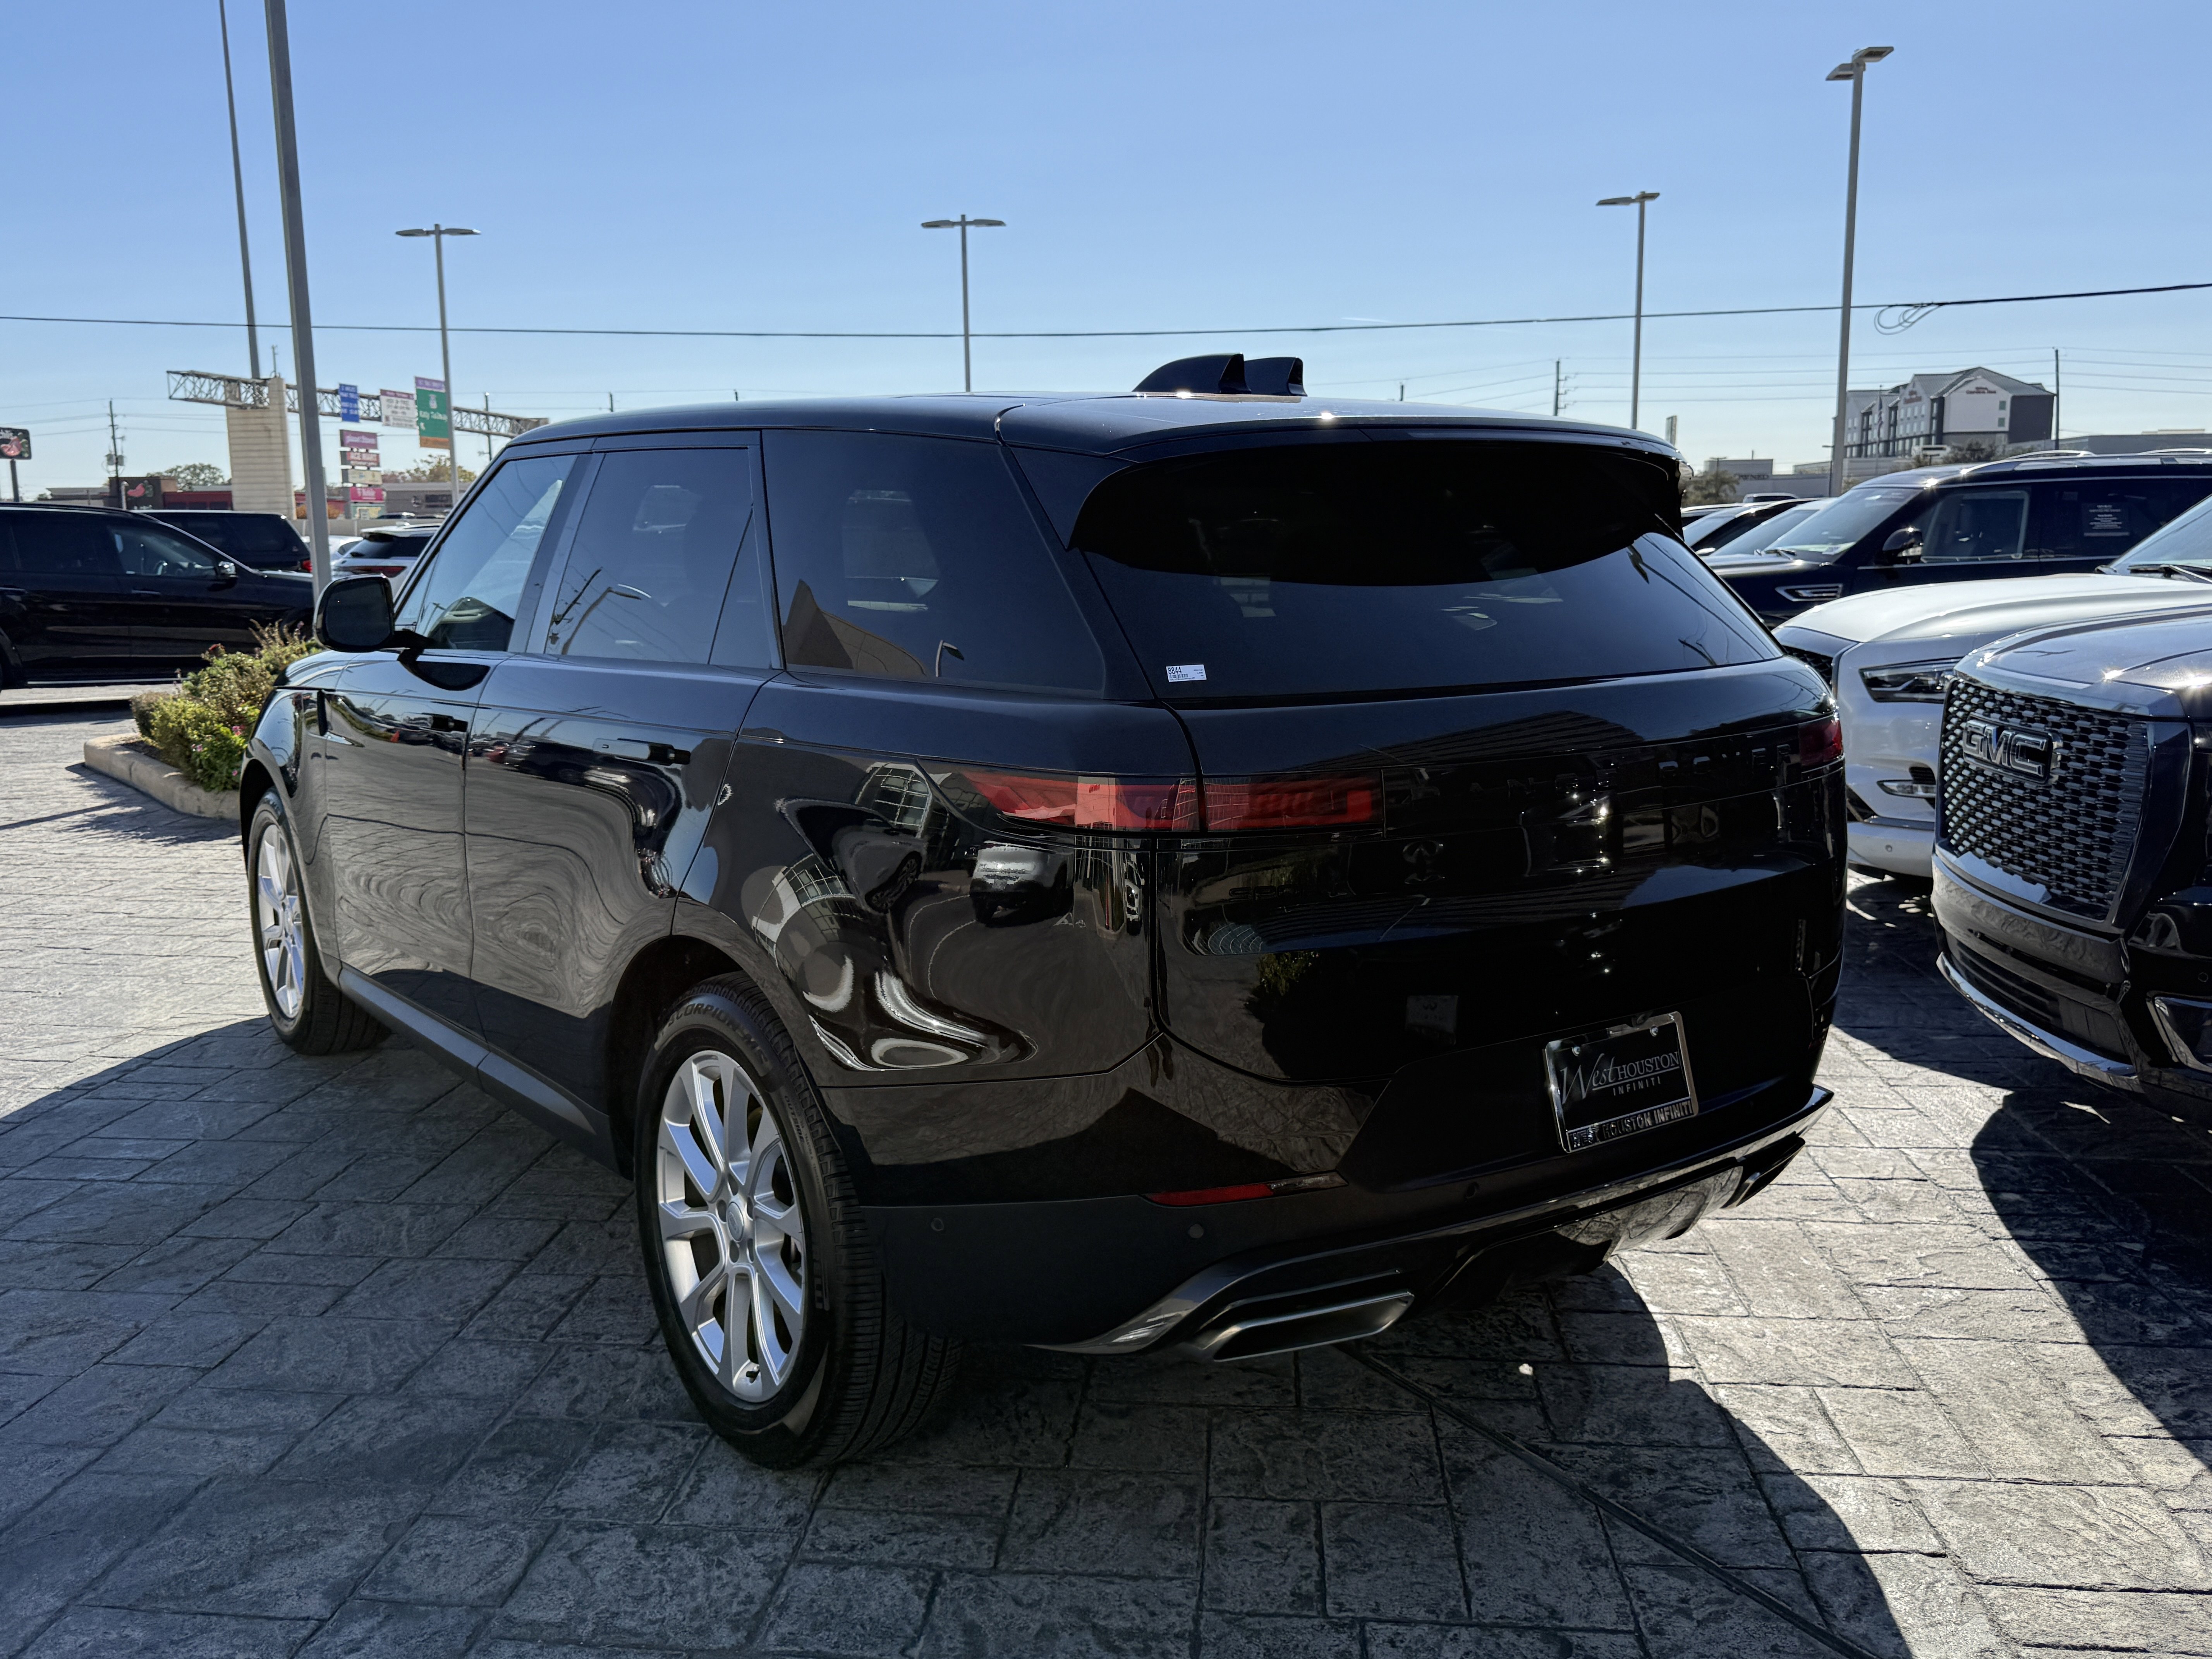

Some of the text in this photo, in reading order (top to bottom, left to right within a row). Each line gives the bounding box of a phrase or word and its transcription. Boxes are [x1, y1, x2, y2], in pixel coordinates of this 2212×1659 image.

[1168, 666, 1182, 675] 8844
[1657, 743, 1794, 781] ROER
[1963, 719, 2047, 777] GMC
[668, 1003, 742, 1032] SCORPION
[1560, 1051, 1680, 1105] West HOUSTON
[1613, 1076, 1661, 1096] INFINITI
[1569, 1100, 1693, 1148] WEST HOUSTON INFINITI
